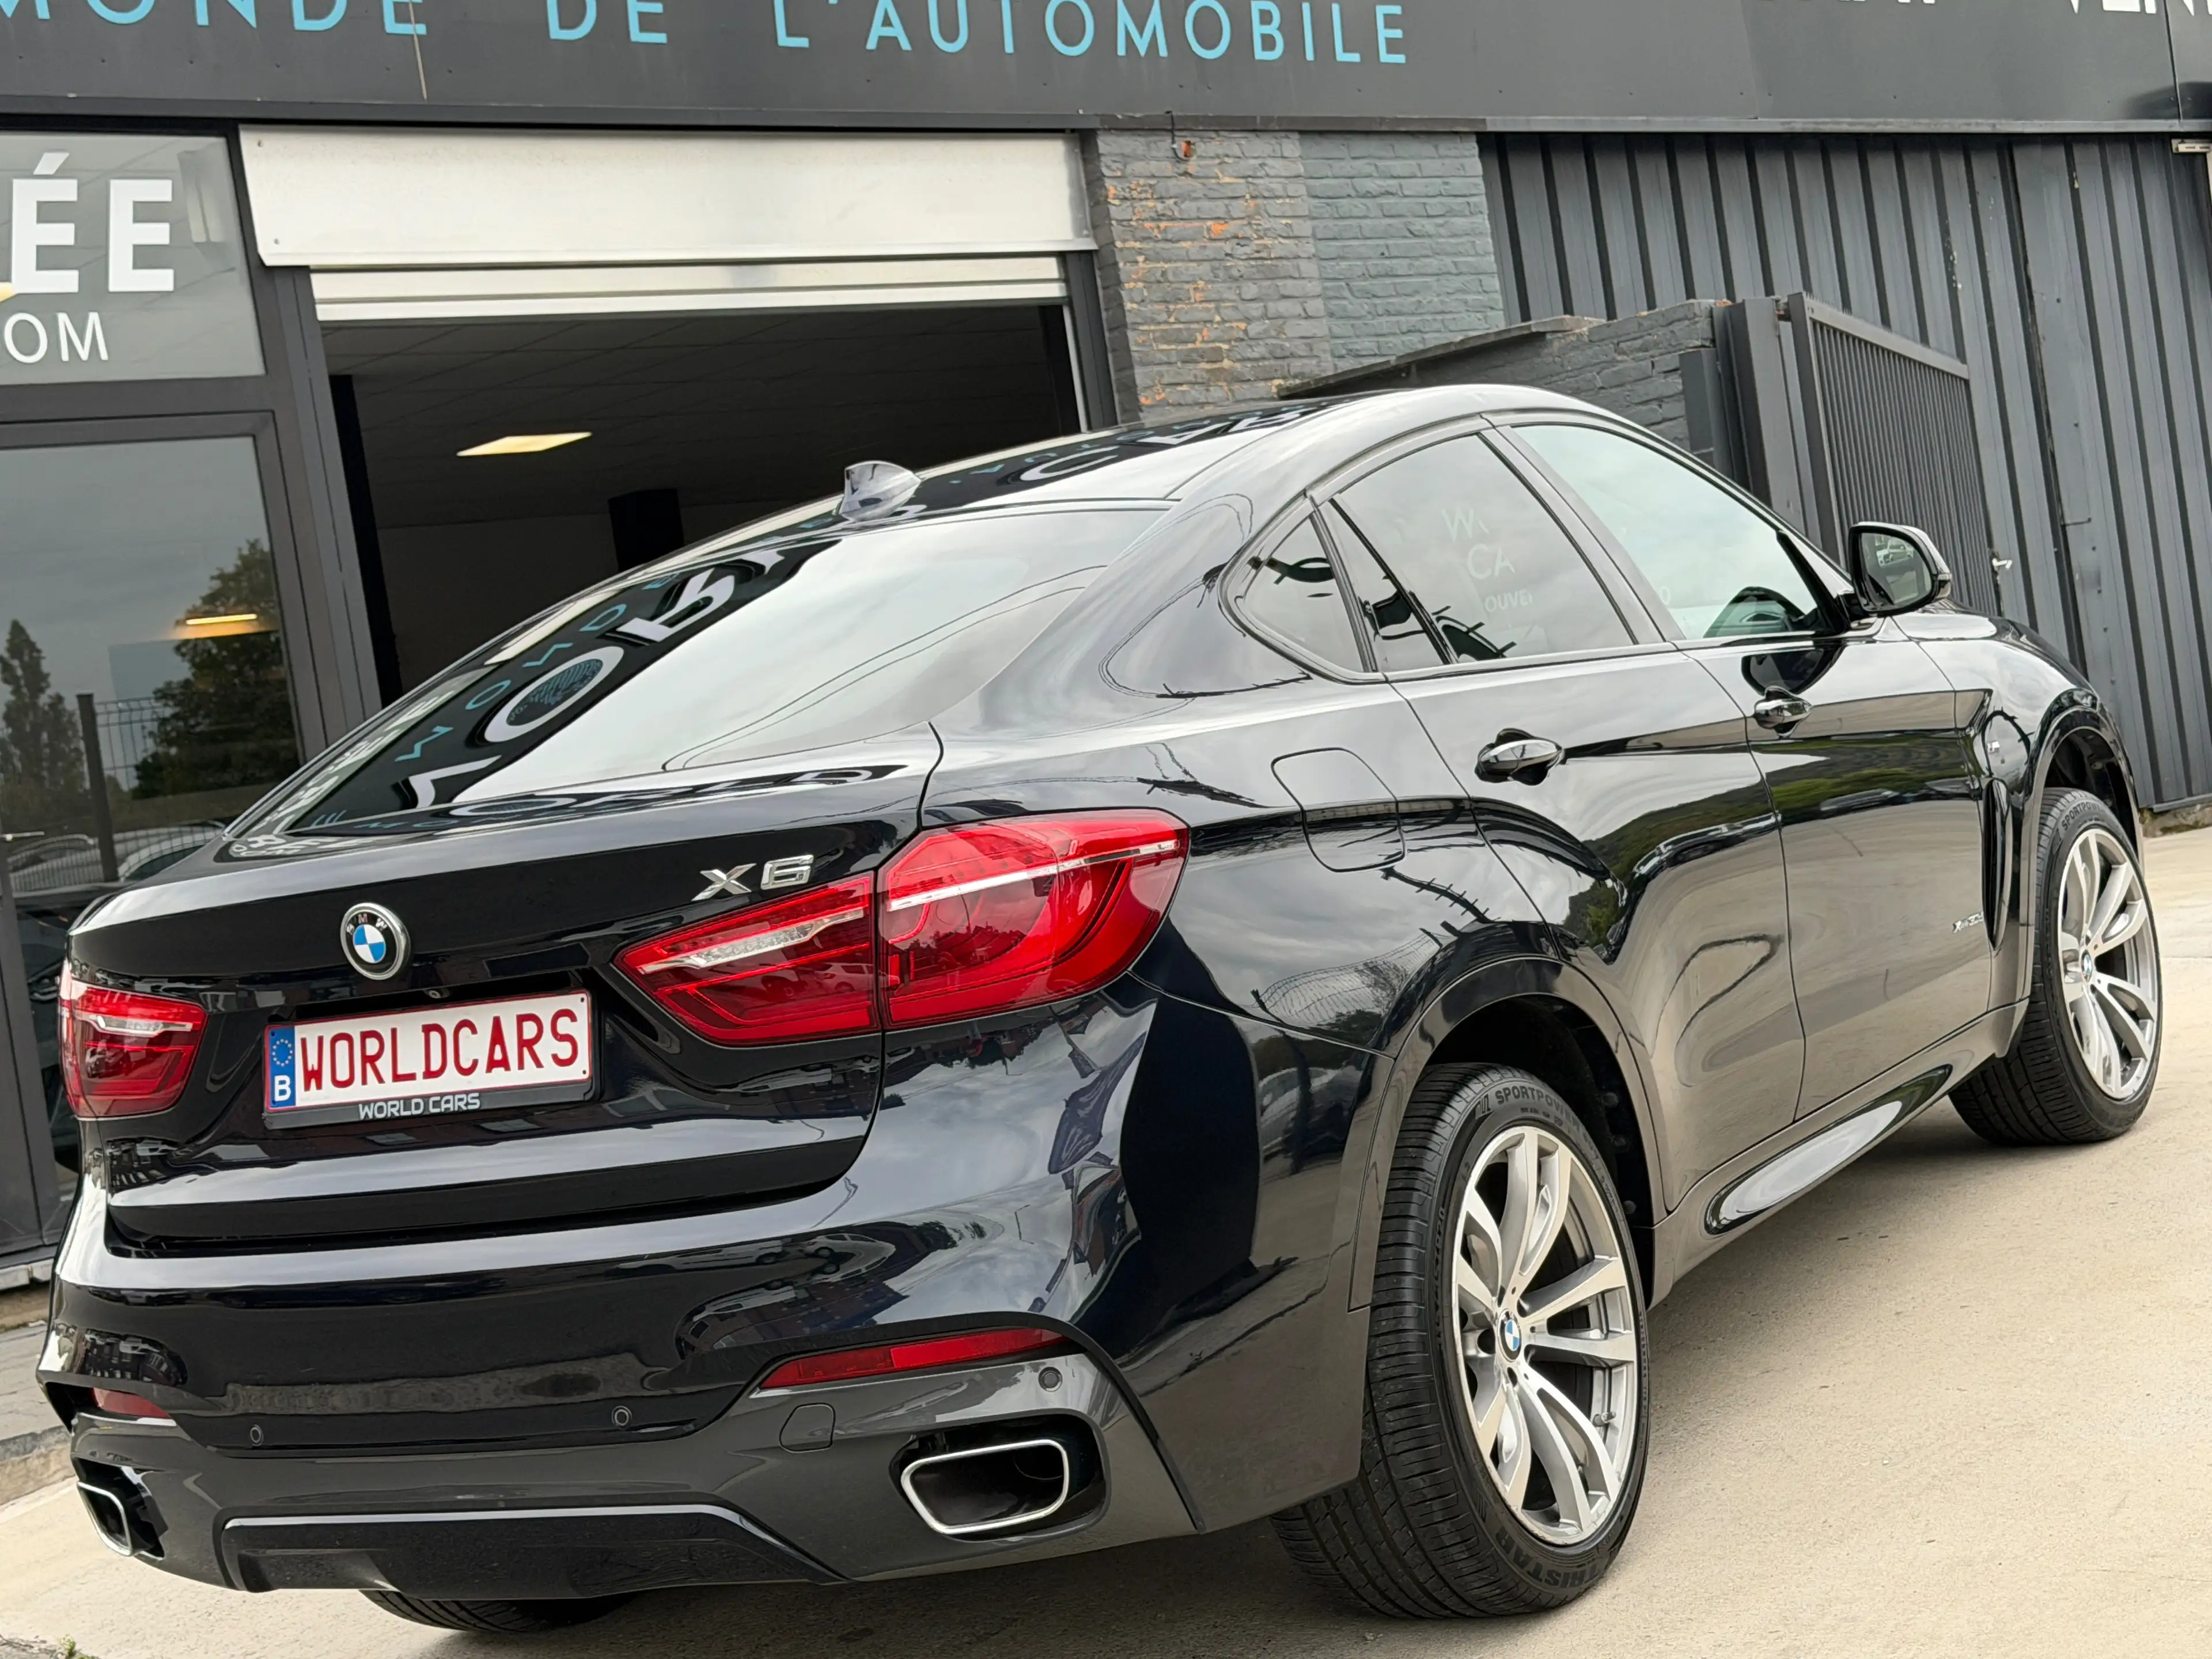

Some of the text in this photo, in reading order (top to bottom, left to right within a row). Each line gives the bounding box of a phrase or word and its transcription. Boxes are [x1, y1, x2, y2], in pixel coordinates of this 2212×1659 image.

[0, 0, 1406, 64] NDE DE LAUTOMOBILE
[1484, 588, 1533, 613] OUVE
[691, 854, 815, 902] X6
[346, 912, 388, 936] BMW
[274, 1008, 579, 1101] B WORLDCARS
[358, 1092, 481, 1120] WORLD CARS
